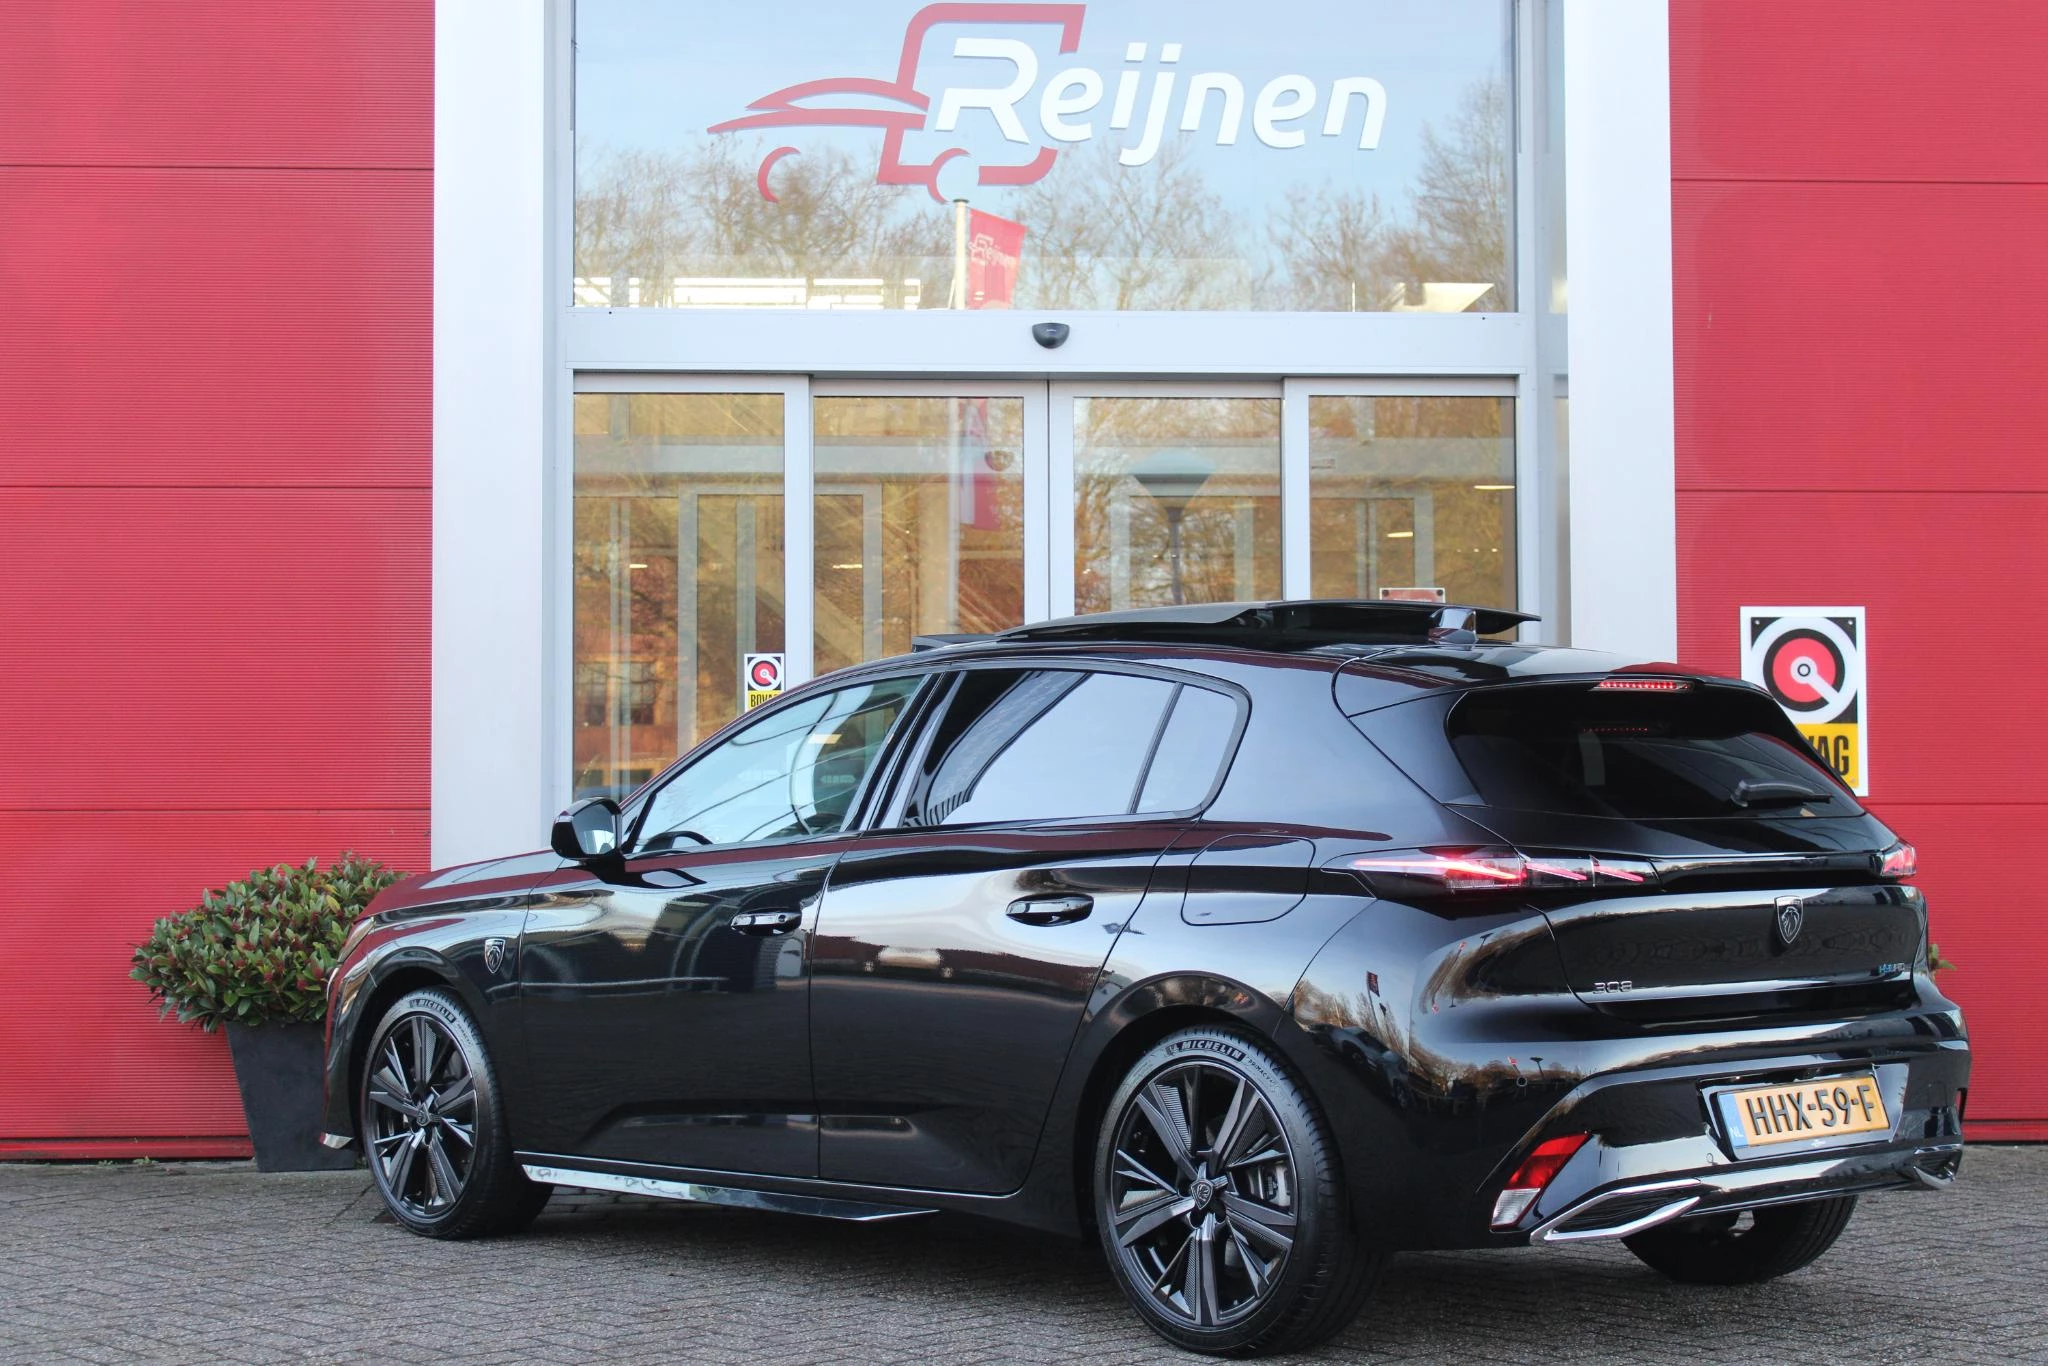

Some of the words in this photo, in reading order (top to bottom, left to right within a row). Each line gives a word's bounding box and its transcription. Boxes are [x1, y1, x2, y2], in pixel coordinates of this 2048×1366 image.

[935, 37, 1388, 167] Reijnen
[1593, 981, 1632, 993] 308
[419, 1000, 455, 1022] MICHELIN
[1181, 1039, 1242, 1060] MICHELIN
[1746, 1084, 1875, 1136] HHX-59-F
[1730, 1126, 1745, 1140] NL
